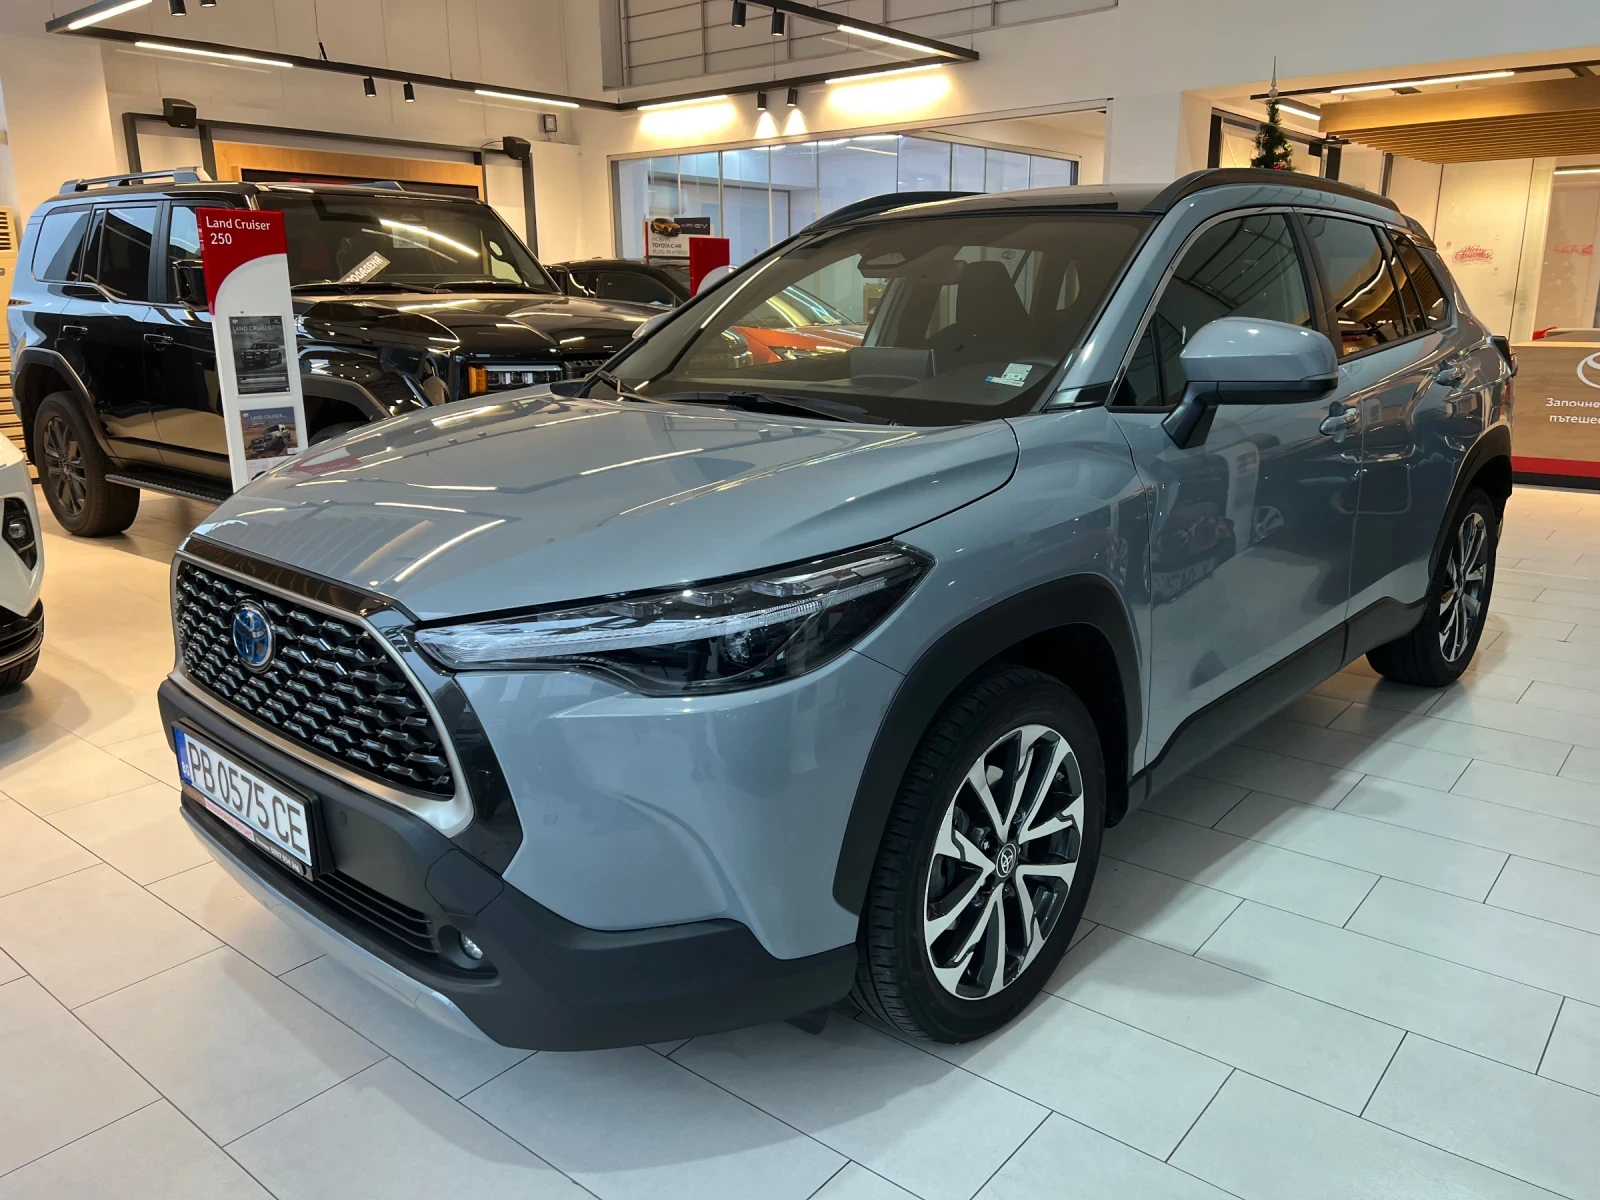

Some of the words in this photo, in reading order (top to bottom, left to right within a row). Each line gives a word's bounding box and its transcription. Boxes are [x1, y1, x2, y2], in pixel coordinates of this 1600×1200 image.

[205, 215, 233, 229] Land
[234, 218, 271, 231] Cruiser
[210, 232, 233, 245] 250
[343, 255, 384, 283] РОДАДЕНА
[1545, 397, 1600, 408] Започне
[188, 741, 215, 794] PB
[217, 761, 269, 830] 0575
[272, 795, 307, 856] CE
